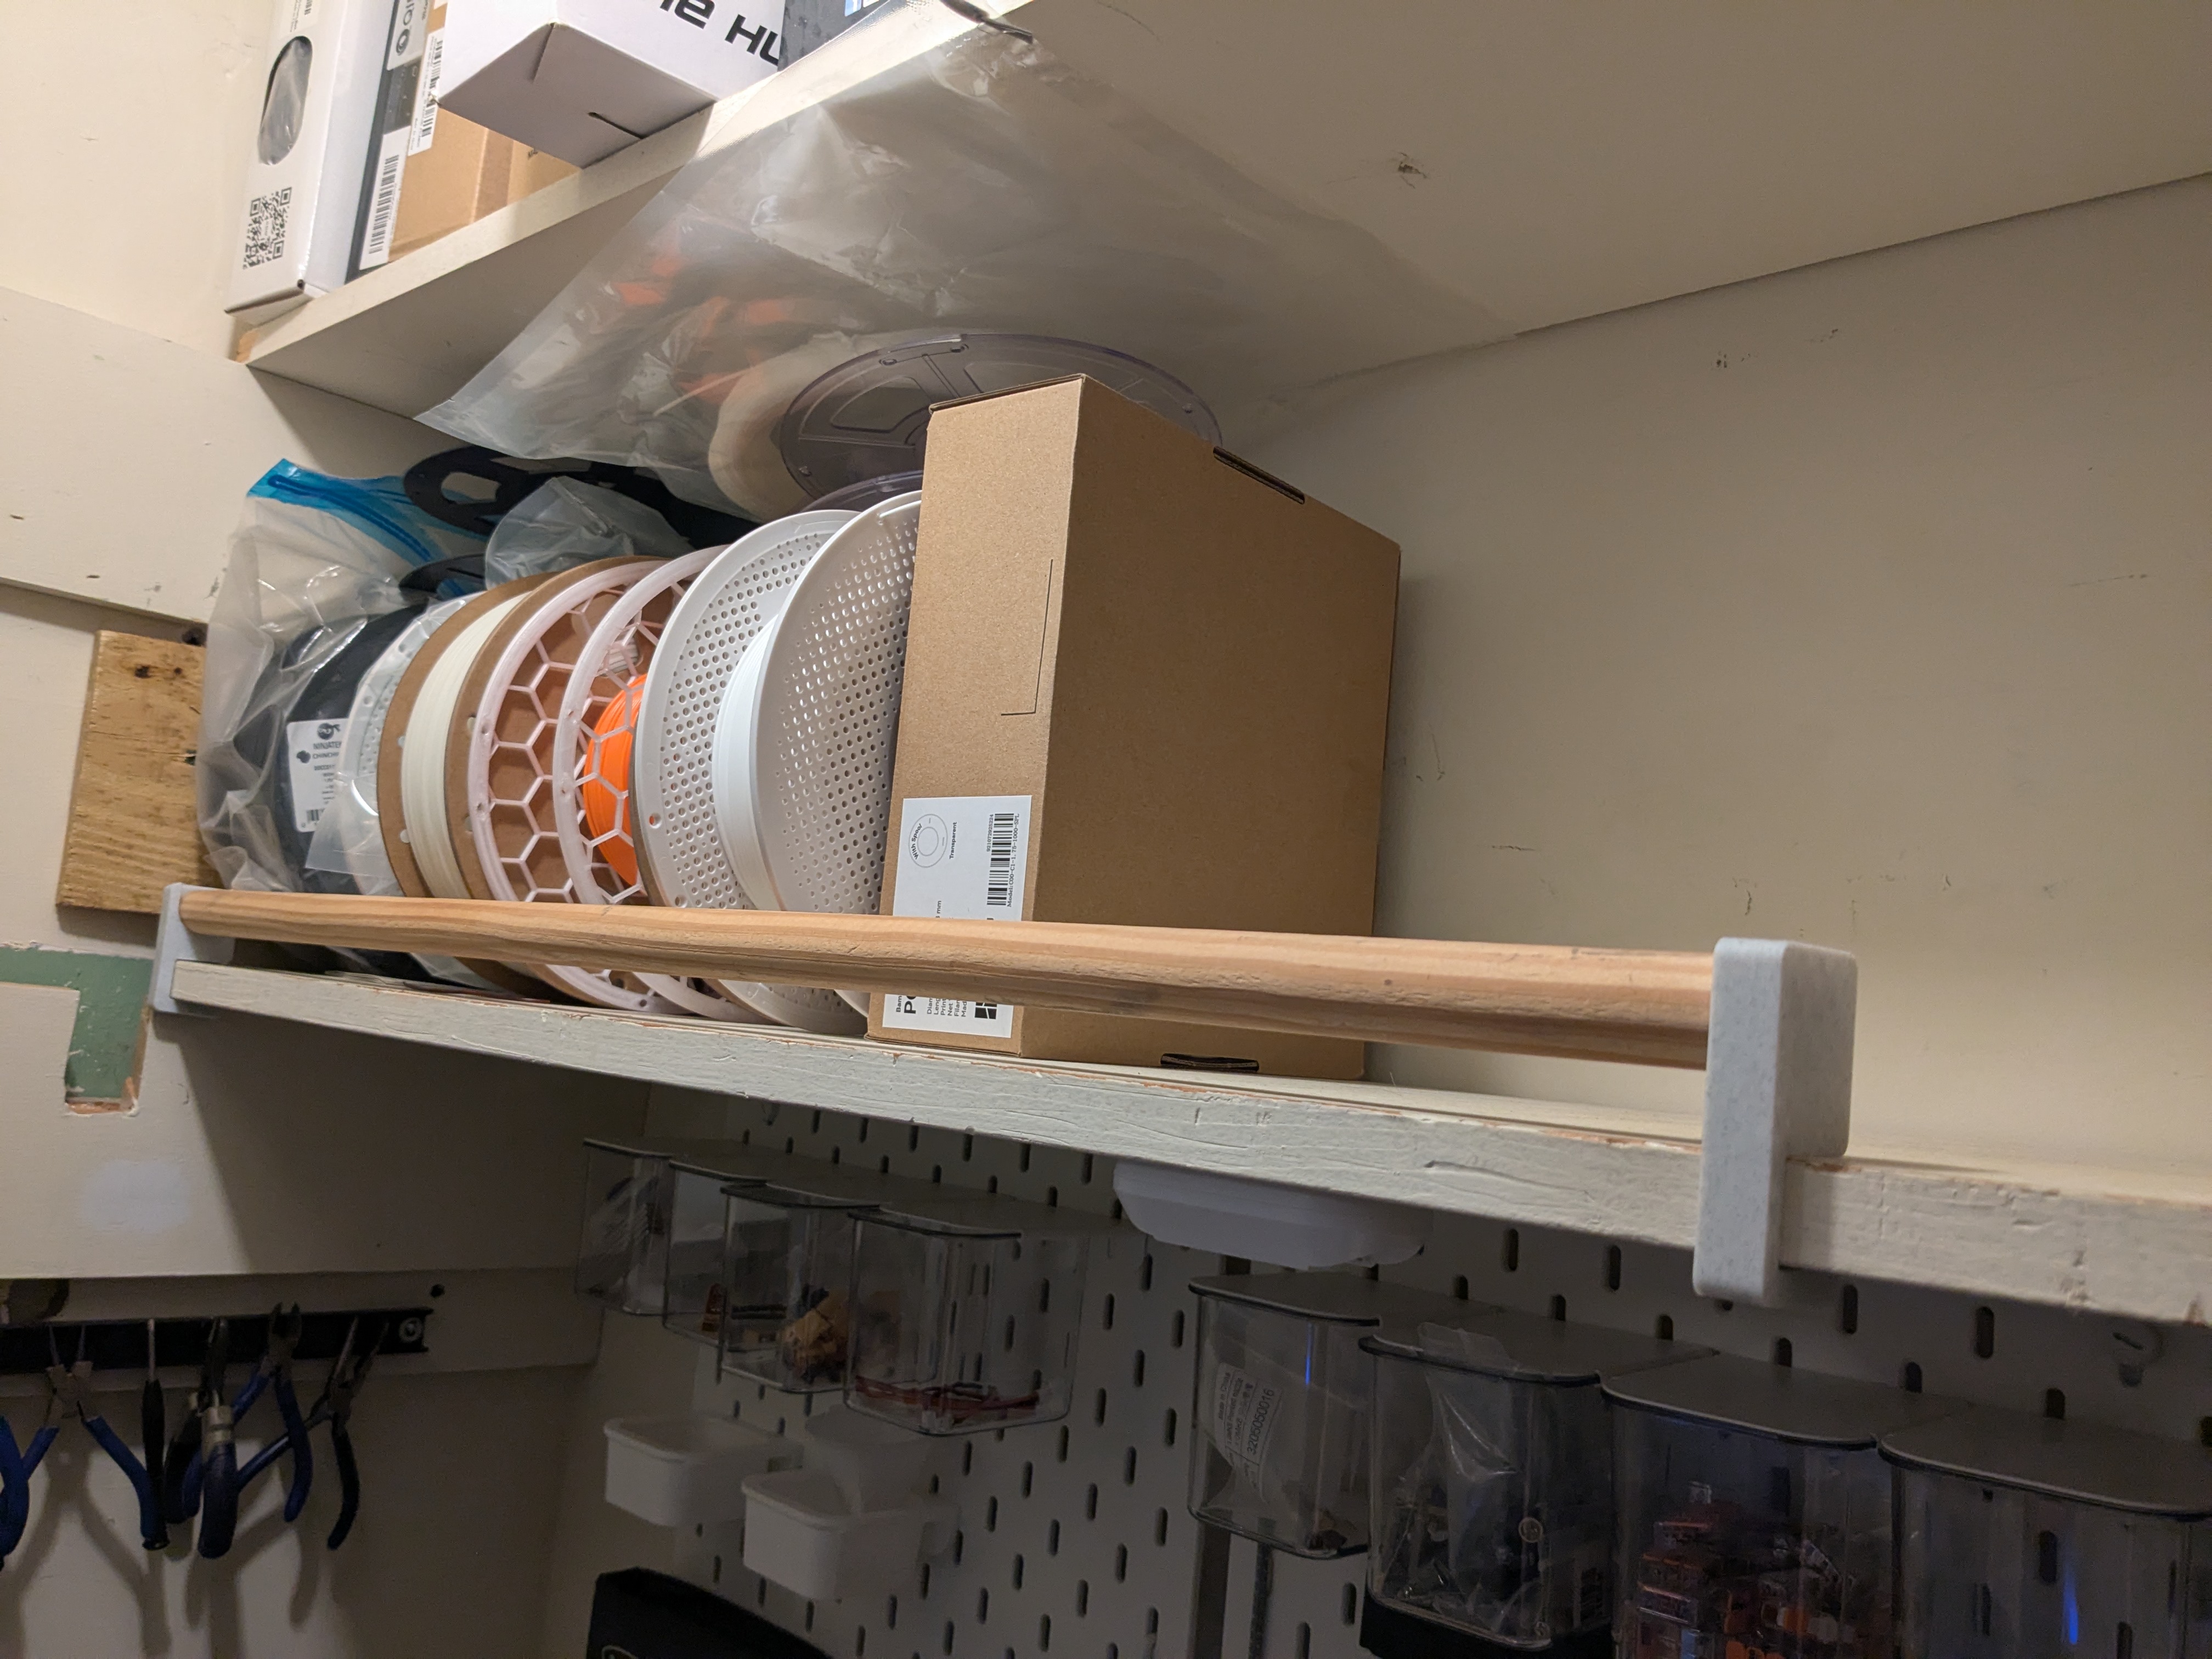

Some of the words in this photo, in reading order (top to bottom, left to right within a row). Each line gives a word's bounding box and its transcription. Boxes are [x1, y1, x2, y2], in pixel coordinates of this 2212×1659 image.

[659, 0, 715, 29] e
[911, 823, 922, 842] Spool
[949, 822, 957, 860] Transparent
[911, 843, 919, 860] With
